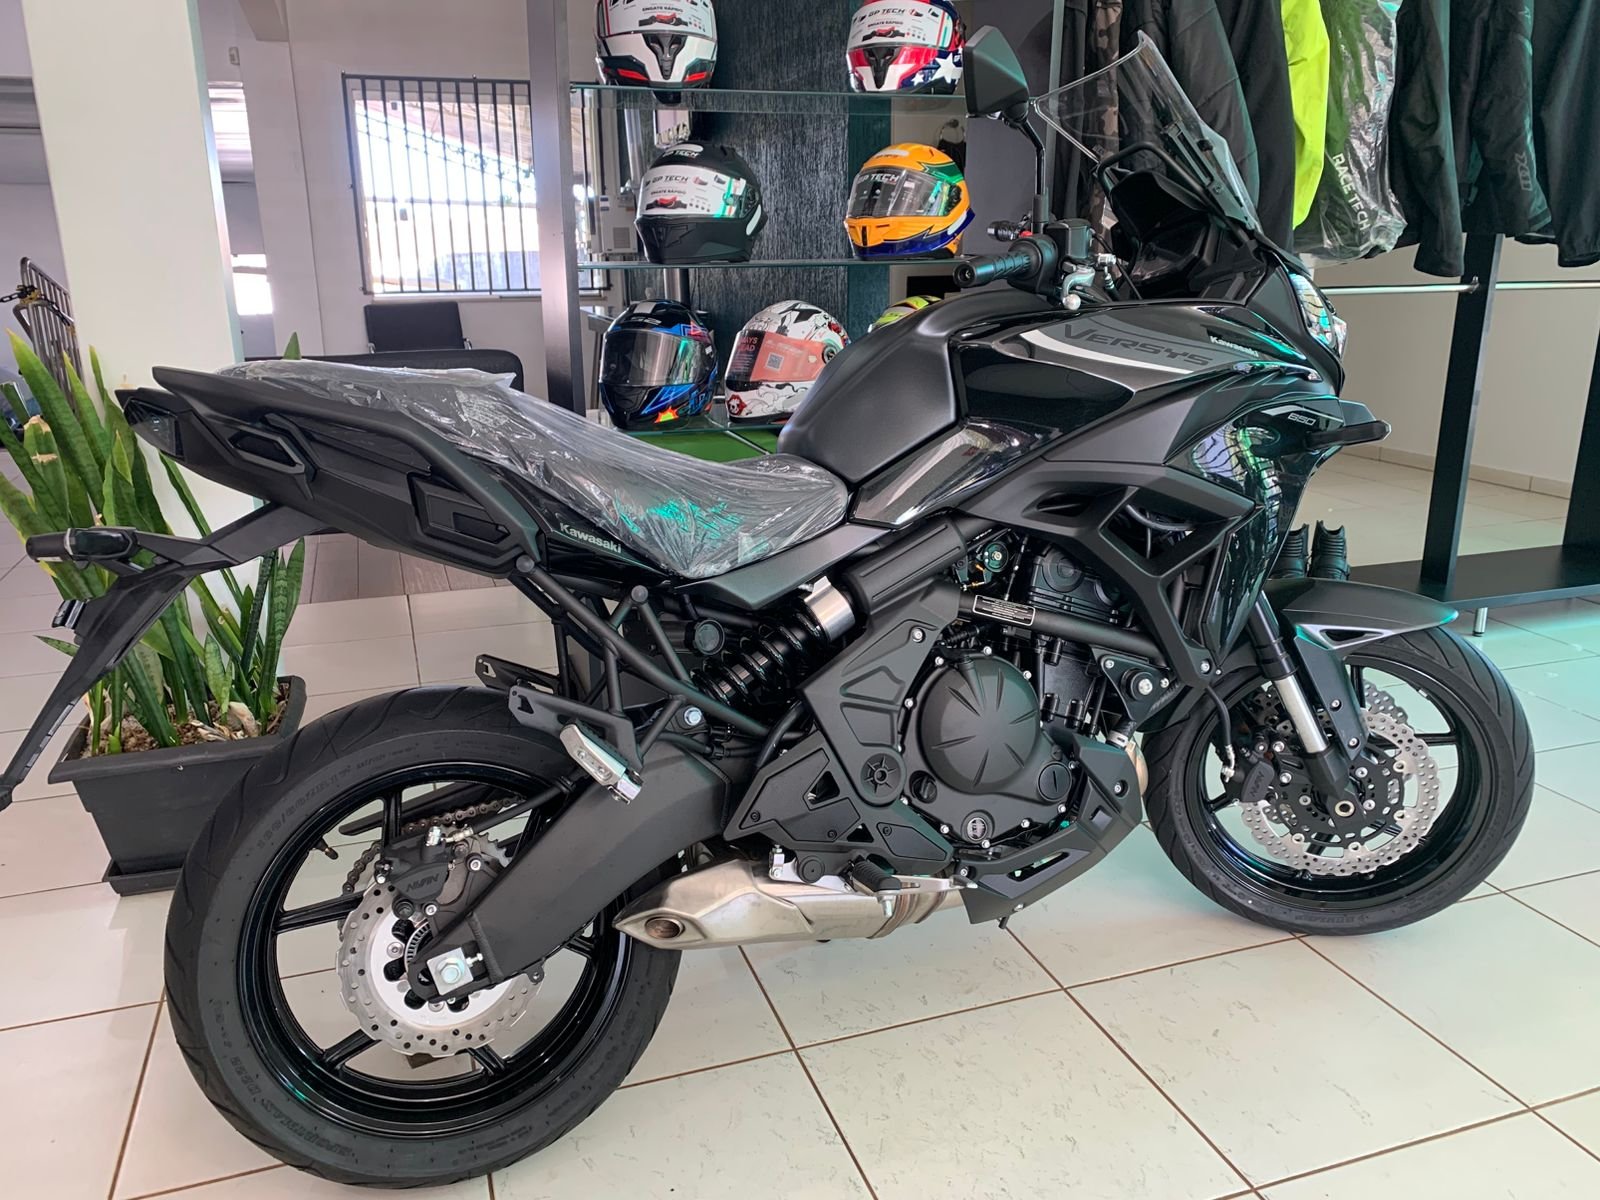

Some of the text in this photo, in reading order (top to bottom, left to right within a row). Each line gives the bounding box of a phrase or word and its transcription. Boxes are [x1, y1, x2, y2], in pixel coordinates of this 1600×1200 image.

[870, 174, 900, 182] TECH
[1332, 153, 1371, 232] RACE TECH
[1065, 324, 1212, 366] VERSYS
[1210, 335, 1259, 357] Kawasaki
[1288, 412, 1316, 426] 650
[560, 522, 622, 554] Kawasaki
